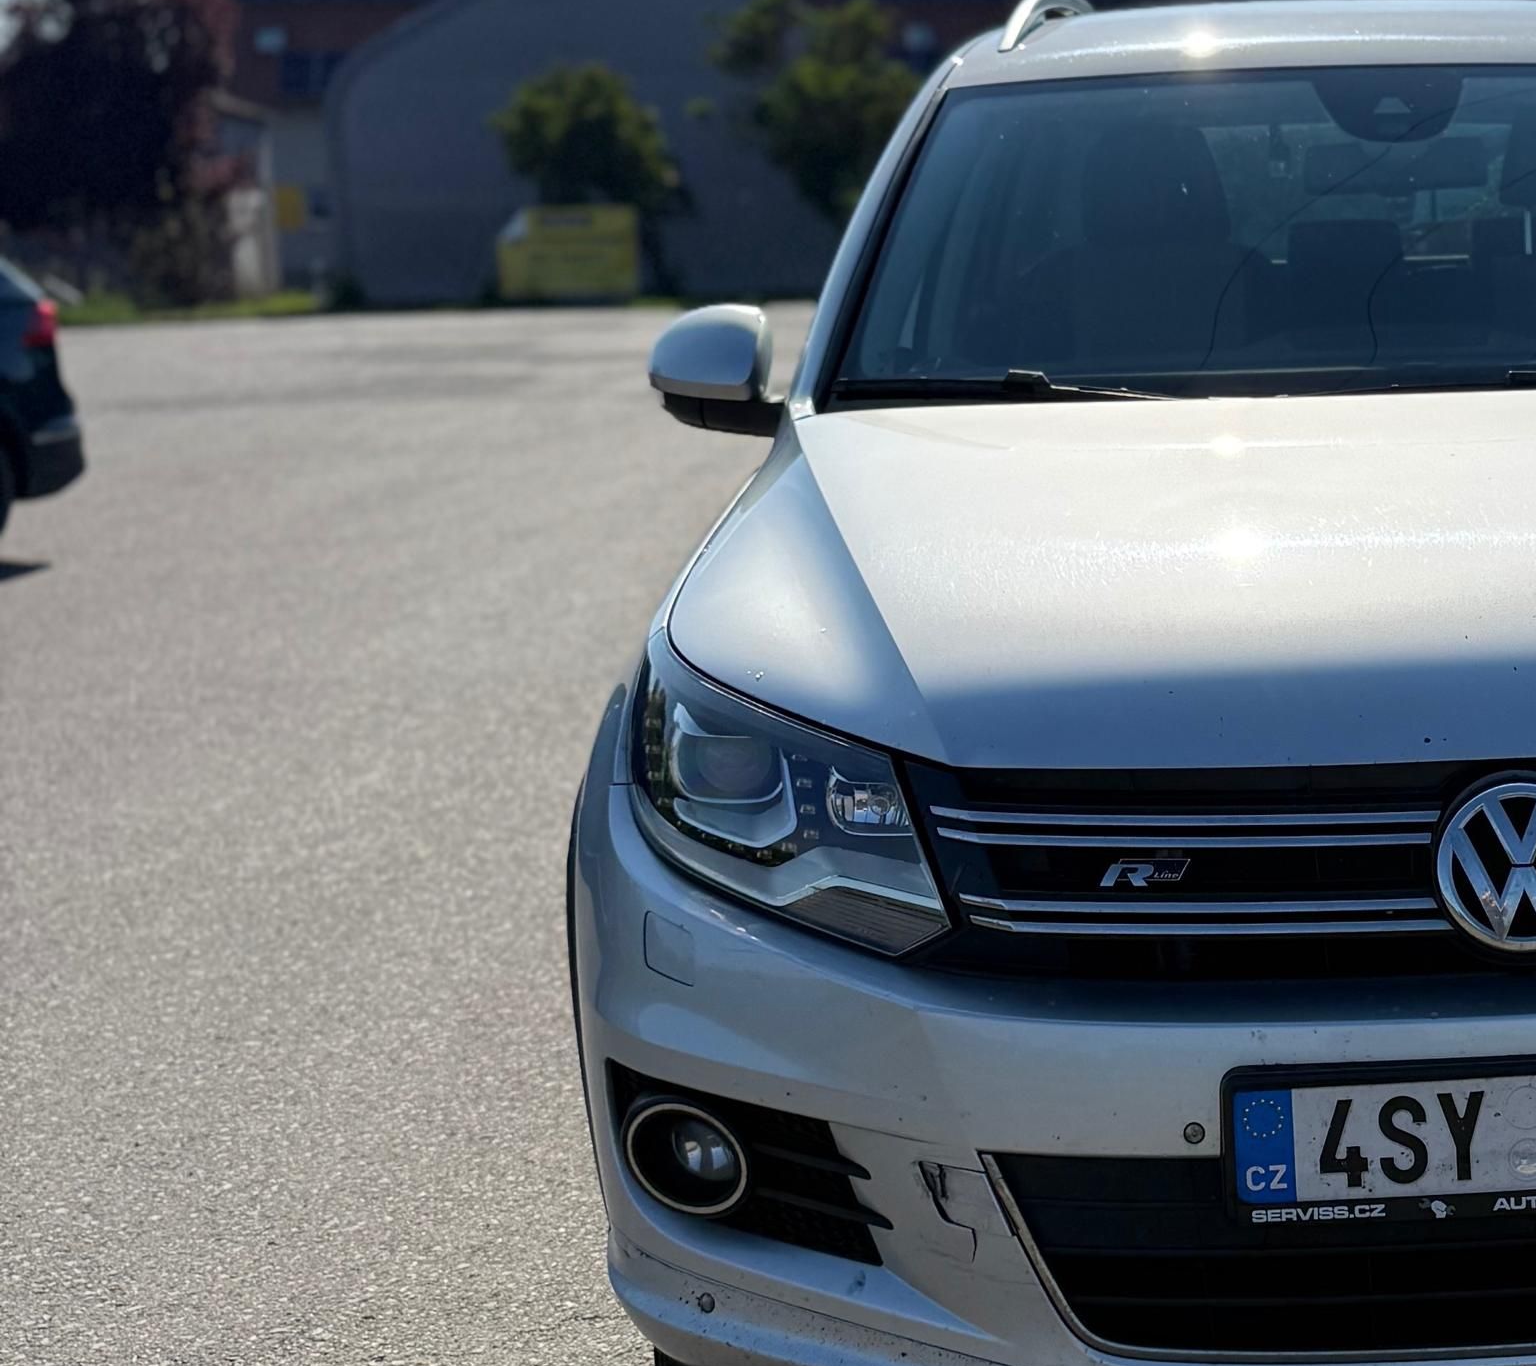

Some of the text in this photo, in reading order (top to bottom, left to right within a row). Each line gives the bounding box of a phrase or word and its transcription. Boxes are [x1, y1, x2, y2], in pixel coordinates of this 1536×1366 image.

[1100, 864, 1154, 886] R
[1319, 1090, 1486, 1188] 4SY
[1245, 1164, 1288, 1192] CZ
[1251, 1203, 1386, 1224] SERVISS.CZ
